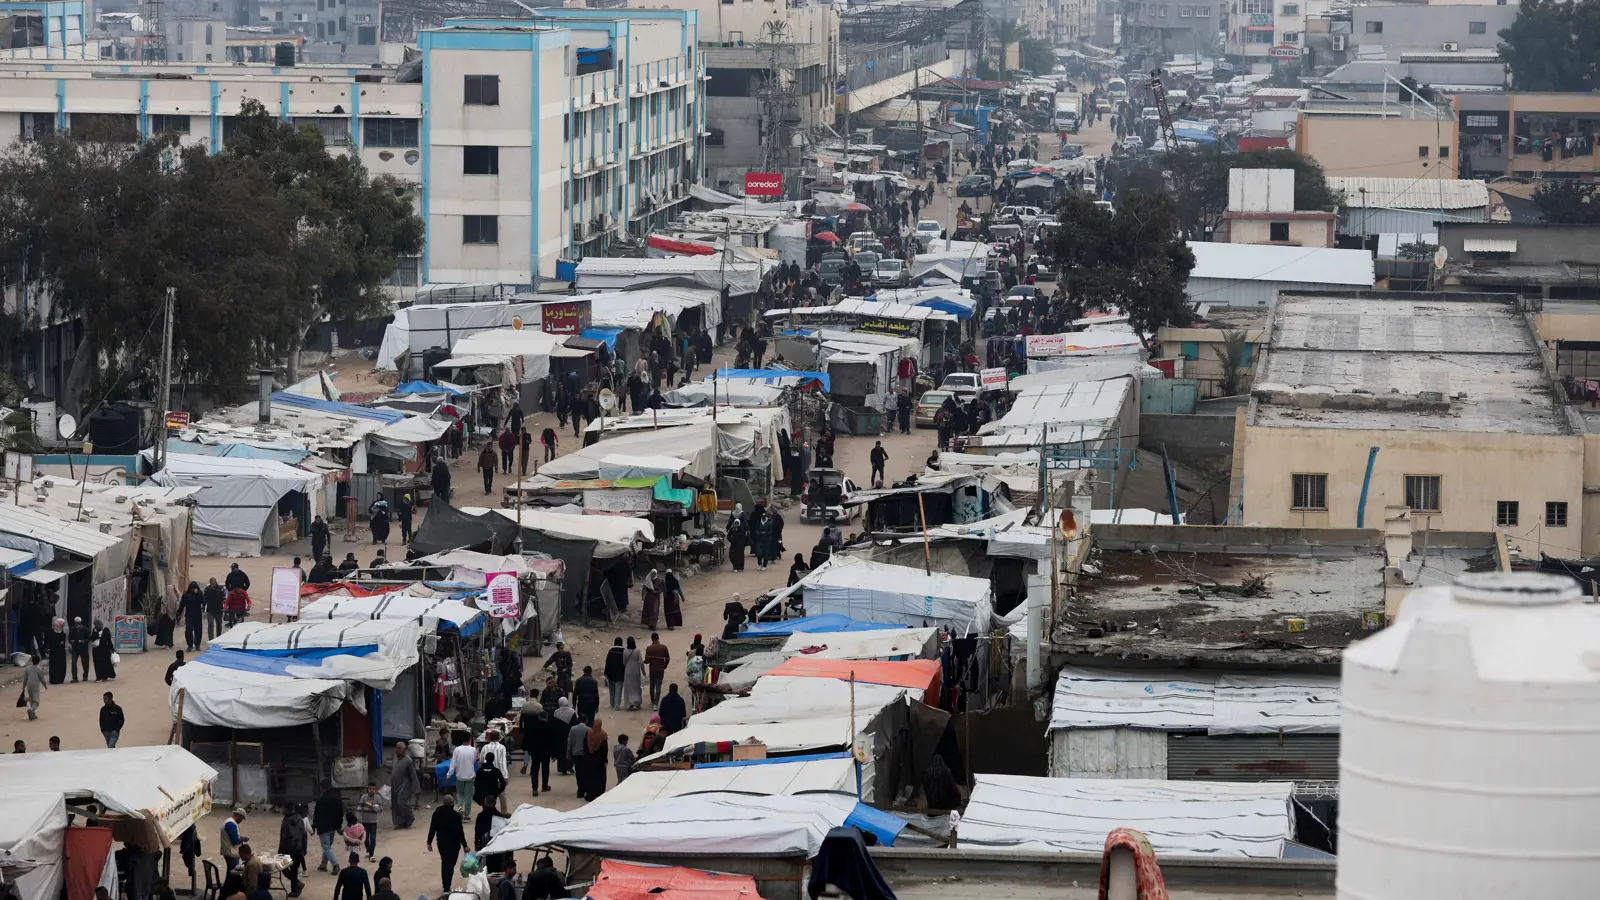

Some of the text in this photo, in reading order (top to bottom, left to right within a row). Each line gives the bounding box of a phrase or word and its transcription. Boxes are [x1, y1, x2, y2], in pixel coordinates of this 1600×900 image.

[545, 305, 577, 320] شاورما
[545, 321, 576, 332] معاذ
[860, 319, 910, 331] مطعم القدس
